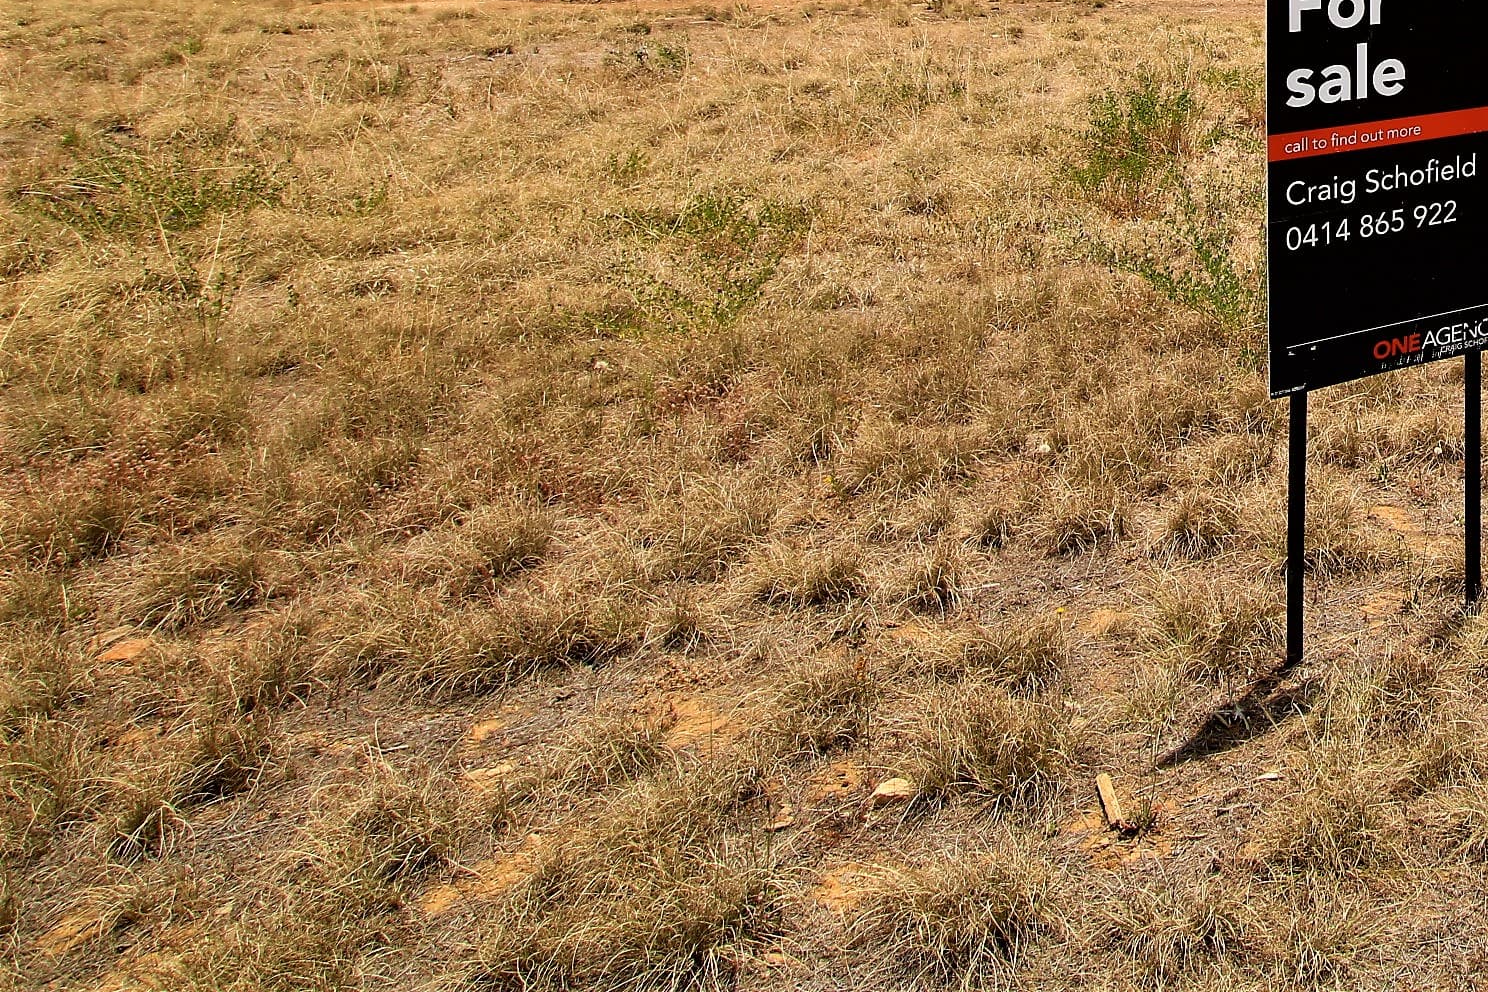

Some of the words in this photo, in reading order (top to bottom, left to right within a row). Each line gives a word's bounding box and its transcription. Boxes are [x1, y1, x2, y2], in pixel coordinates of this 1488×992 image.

[1285, 42, 1406, 108] sale
[1284, 137, 1308, 154] call
[1311, 138, 1327, 150] to
[1331, 130, 1357, 147] find
[1360, 129, 1383, 143] out
[1386, 125, 1422, 139] more
[1286, 175, 1356, 205] Craig
[1365, 152, 1476, 194] Schofield
[1286, 218, 1350, 251] 0414
[1359, 208, 1405, 238] 865
[1413, 199, 1457, 228] 922
